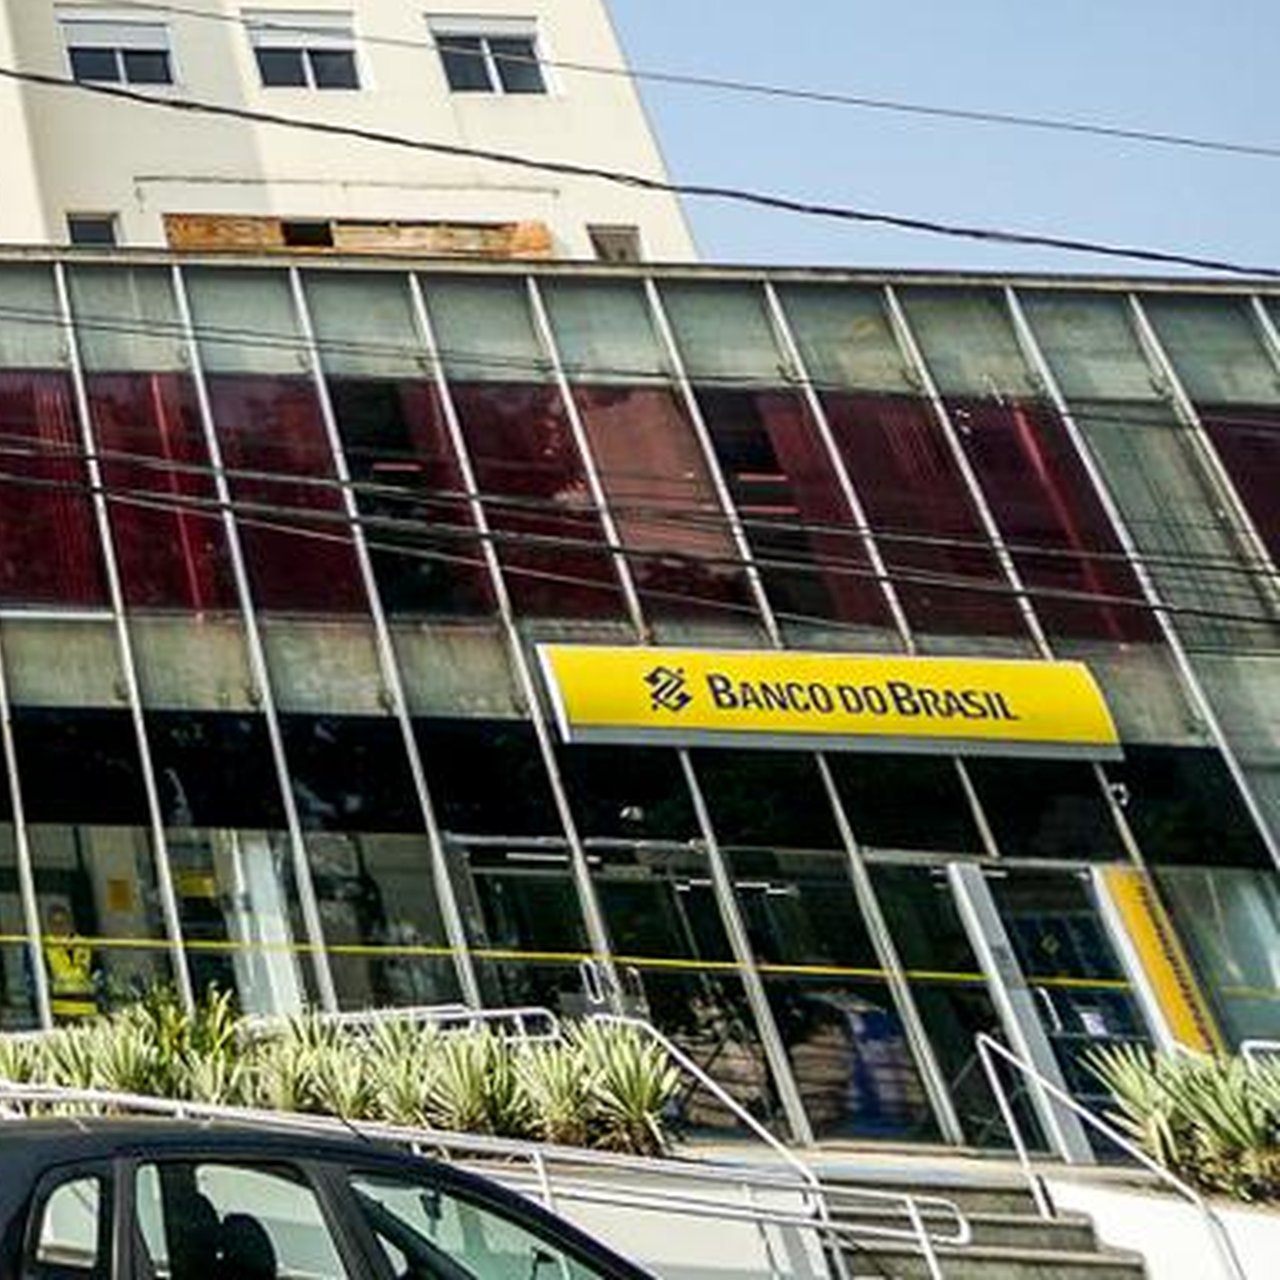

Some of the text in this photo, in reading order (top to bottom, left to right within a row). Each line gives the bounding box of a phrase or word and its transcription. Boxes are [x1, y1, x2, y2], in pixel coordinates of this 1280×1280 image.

[706, 673, 1021, 721] BANCO DO BRASIL
